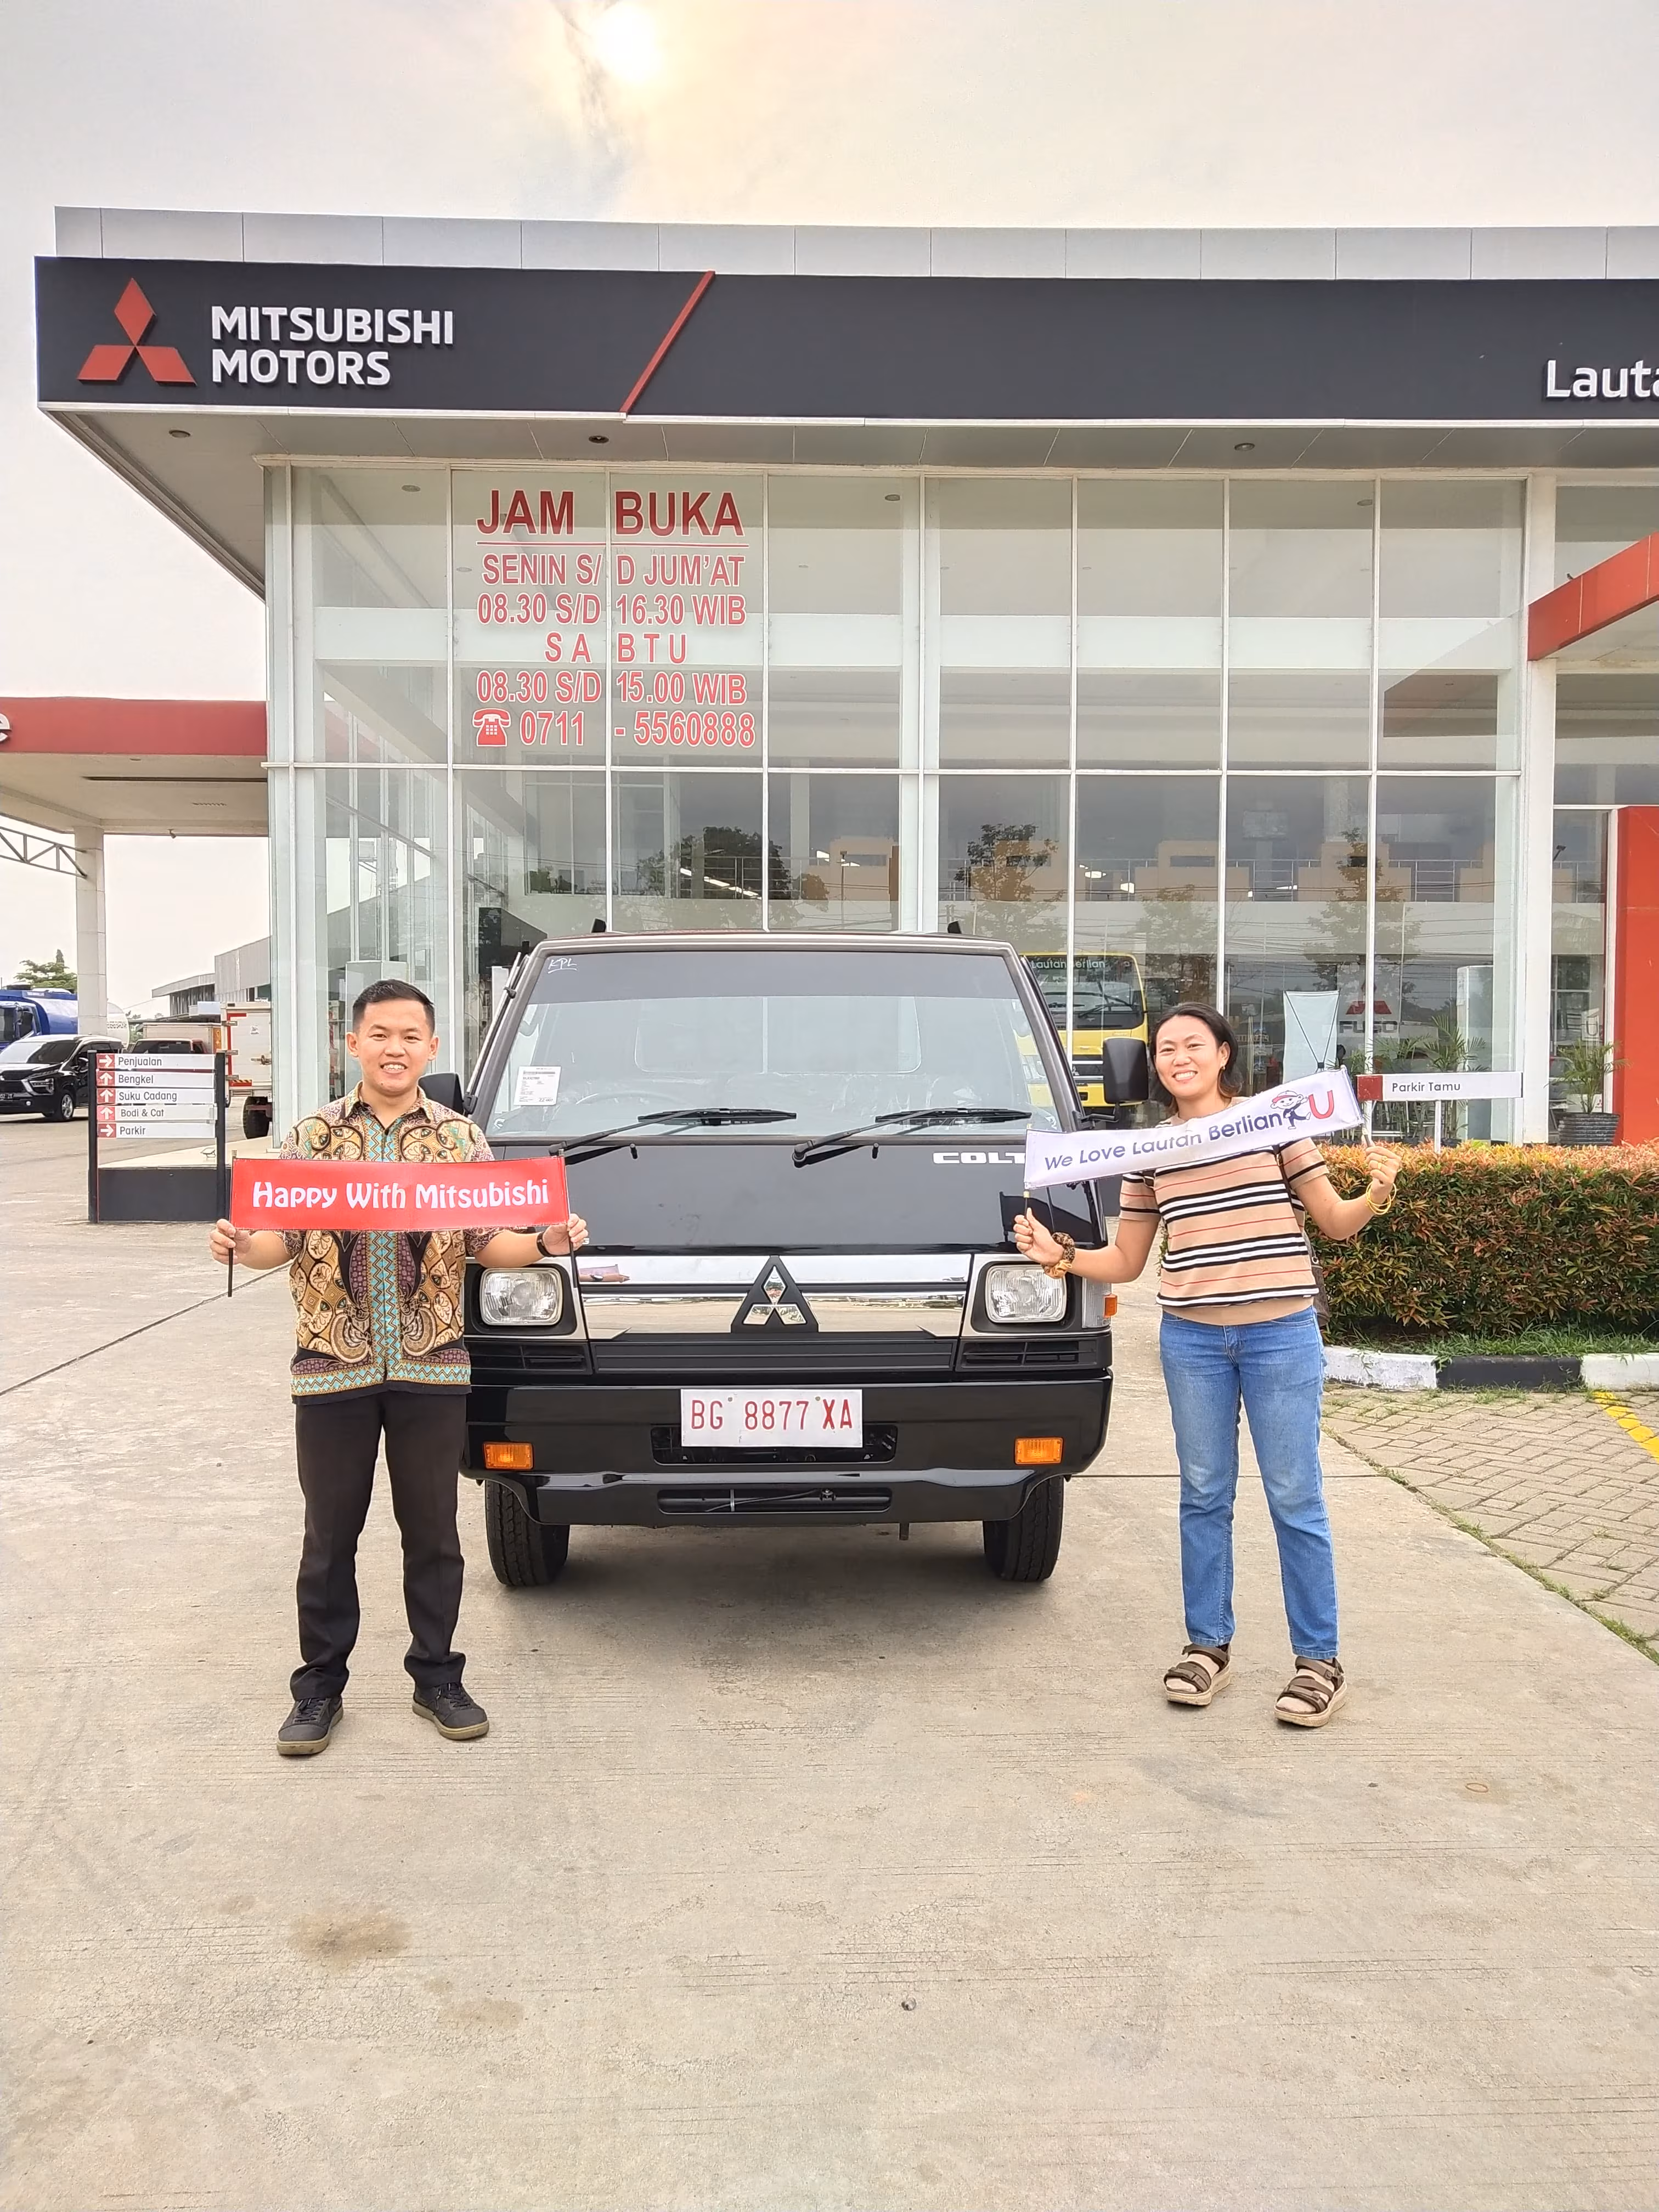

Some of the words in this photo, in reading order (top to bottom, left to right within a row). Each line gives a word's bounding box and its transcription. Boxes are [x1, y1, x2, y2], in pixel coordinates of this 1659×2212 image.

[212, 306, 453, 345] MITSUBISHI
[212, 349, 391, 385] MOTORS
[1546, 359, 1659, 398] Laut
[476, 490, 574, 535] JAM
[614, 492, 744, 537] BUKA
[482, 554, 567, 585] SENIN
[644, 555, 745, 586] JUM'AT
[477, 593, 547, 624] 08.30
[555, 593, 601, 625] S/D
[616, 594, 685, 625] 16.30
[692, 594, 746, 626] WIB
[476, 670, 548, 703] 08.30
[555, 670, 601, 703] S/D
[616, 671, 685, 703] 15.00
[693, 673, 748, 705] WIB
[519, 710, 584, 746] 0711
[634, 710, 755, 748] 5560888
[1031, 960, 1066, 969] Lautan
[1074, 960, 1105, 969] erlian
[118, 1057, 162, 1067] Penjualan
[118, 1074, 154, 1085] Bengkel
[1392, 1082, 1425, 1092] Parkir
[1429, 1081, 1460, 1091] Tamu
[119, 1092, 140, 1101] Suku
[144, 1092, 177, 1102] Cadang
[121, 1109, 139, 1117] Bodi
[142, 1109, 148, 1117] &
[150, 1109, 164, 1117] Cat
[120, 1126, 146, 1135] Parkir
[1045, 1154, 1073, 1170] We
[1080, 1146, 1125, 1164] Love
[1132, 1134, 1202, 1155] Lautan
[1209, 1113, 1283, 1141] Berlian
[1308, 1090, 1334, 1119] U
[933, 1152, 1025, 1164] COLT
[252, 1181, 337, 1208] Happy
[346, 1182, 406, 1209] With
[415, 1178, 549, 1209] Mitsubishi
[691, 1400, 723, 1430] BG
[744, 1401, 809, 1430] 8877
[822, 1399, 853, 1430] XA
